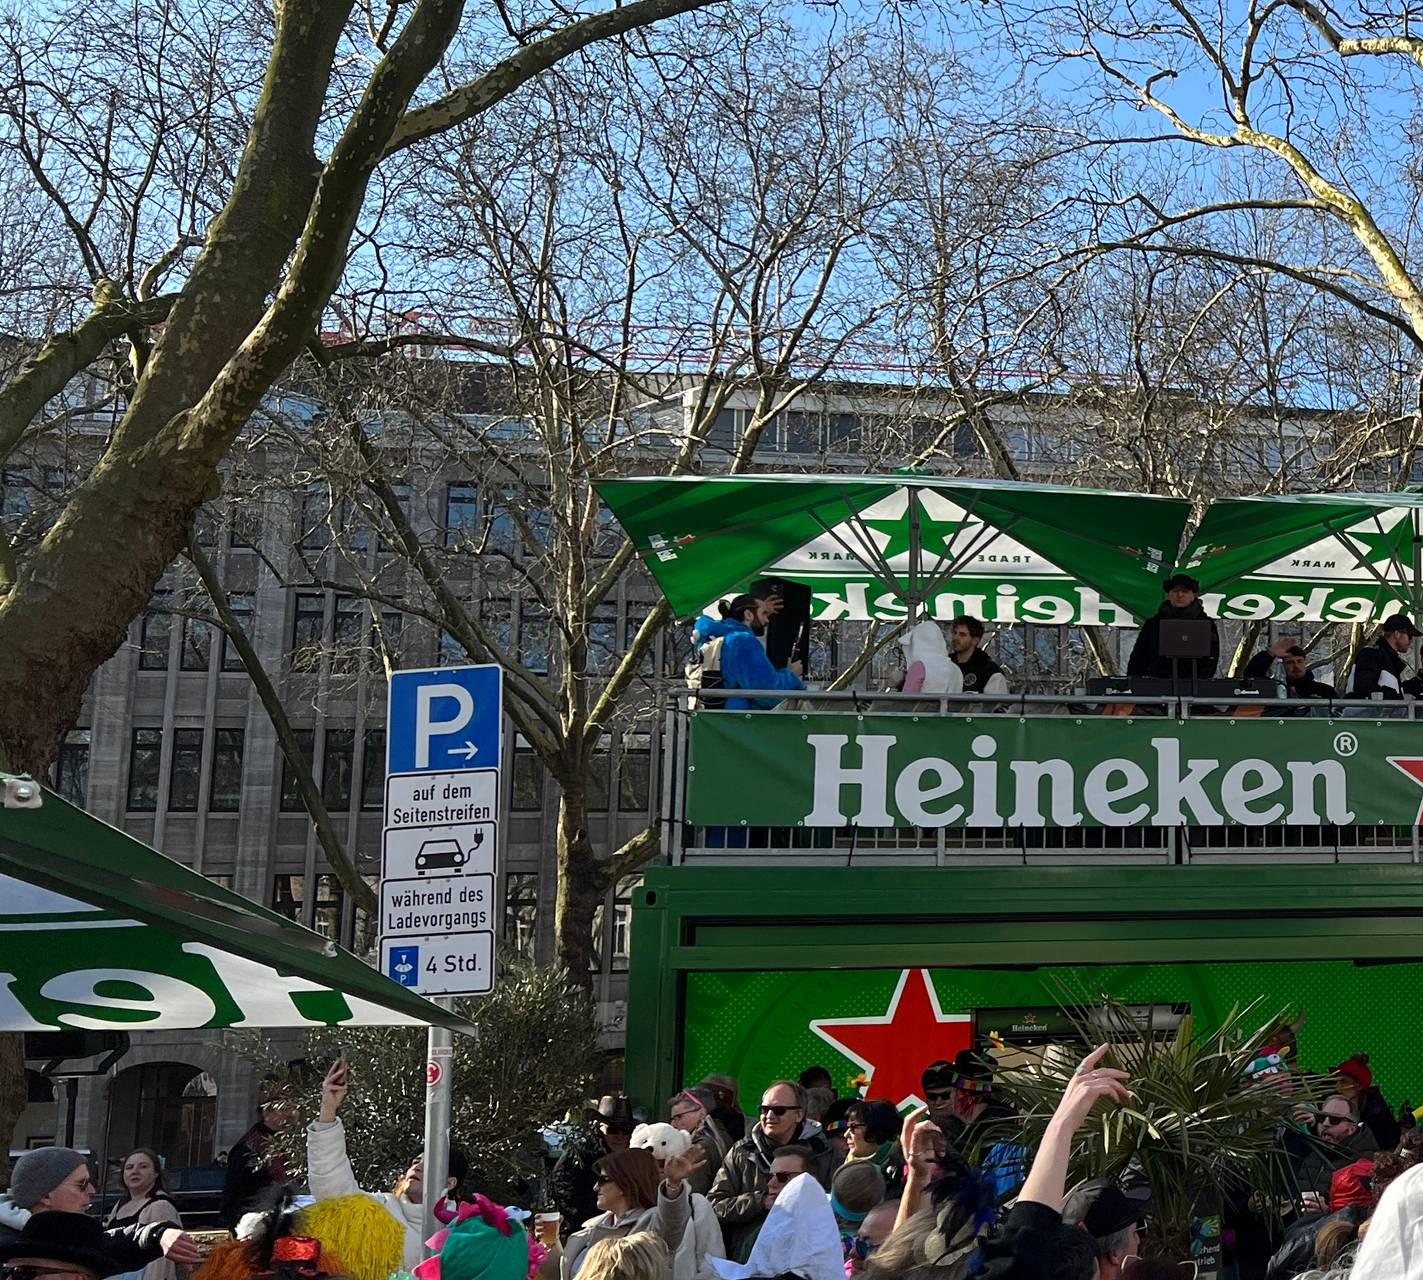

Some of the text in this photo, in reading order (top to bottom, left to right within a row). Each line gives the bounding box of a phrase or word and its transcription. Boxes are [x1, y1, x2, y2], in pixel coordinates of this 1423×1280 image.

[415, 684, 474, 769] P
[803, 734, 1356, 828] Heineken
[413, 783, 471, 801] auf dem
[393, 803, 490, 824] Seitenstreifen
[391, 886, 484, 908] während des
[388, 911, 487, 930] Ladevorgangs
[425, 953, 482, 974] 4 Std.
[1011, 1024, 1047, 1032] Heineken
